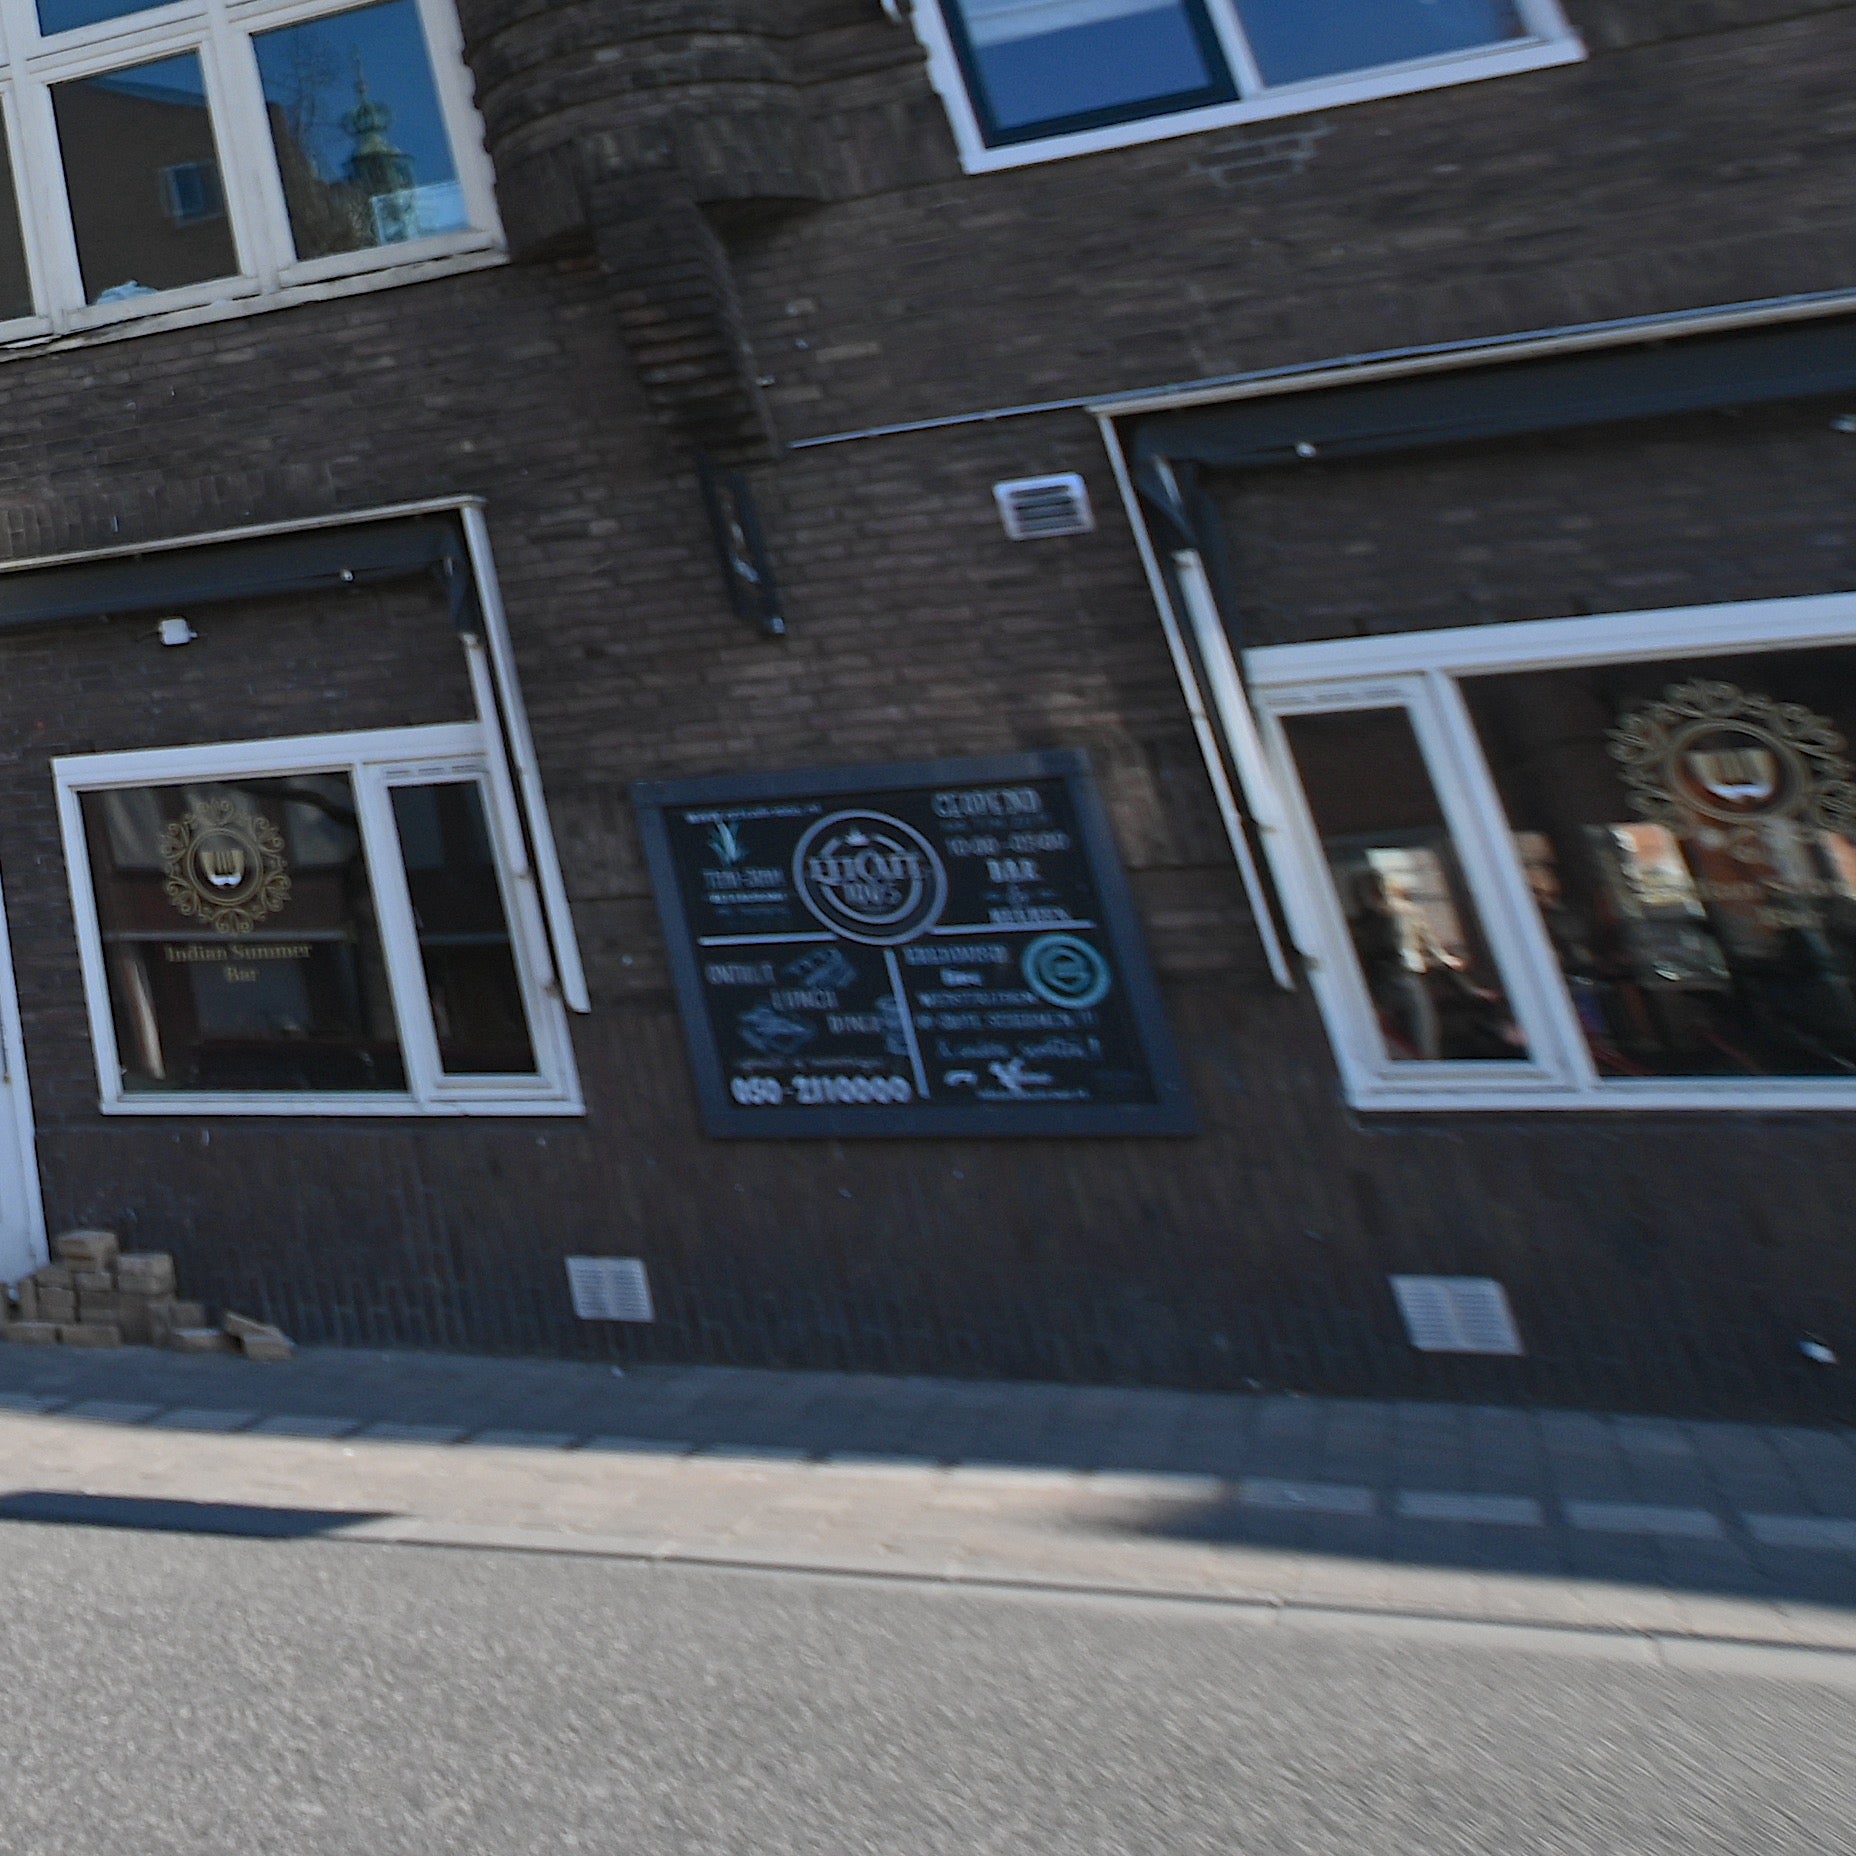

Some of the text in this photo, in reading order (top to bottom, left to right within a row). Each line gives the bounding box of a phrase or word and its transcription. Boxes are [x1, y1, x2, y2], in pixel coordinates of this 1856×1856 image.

[166, 945, 312, 962] Indian Summer
[226, 967, 259, 982] Bar
